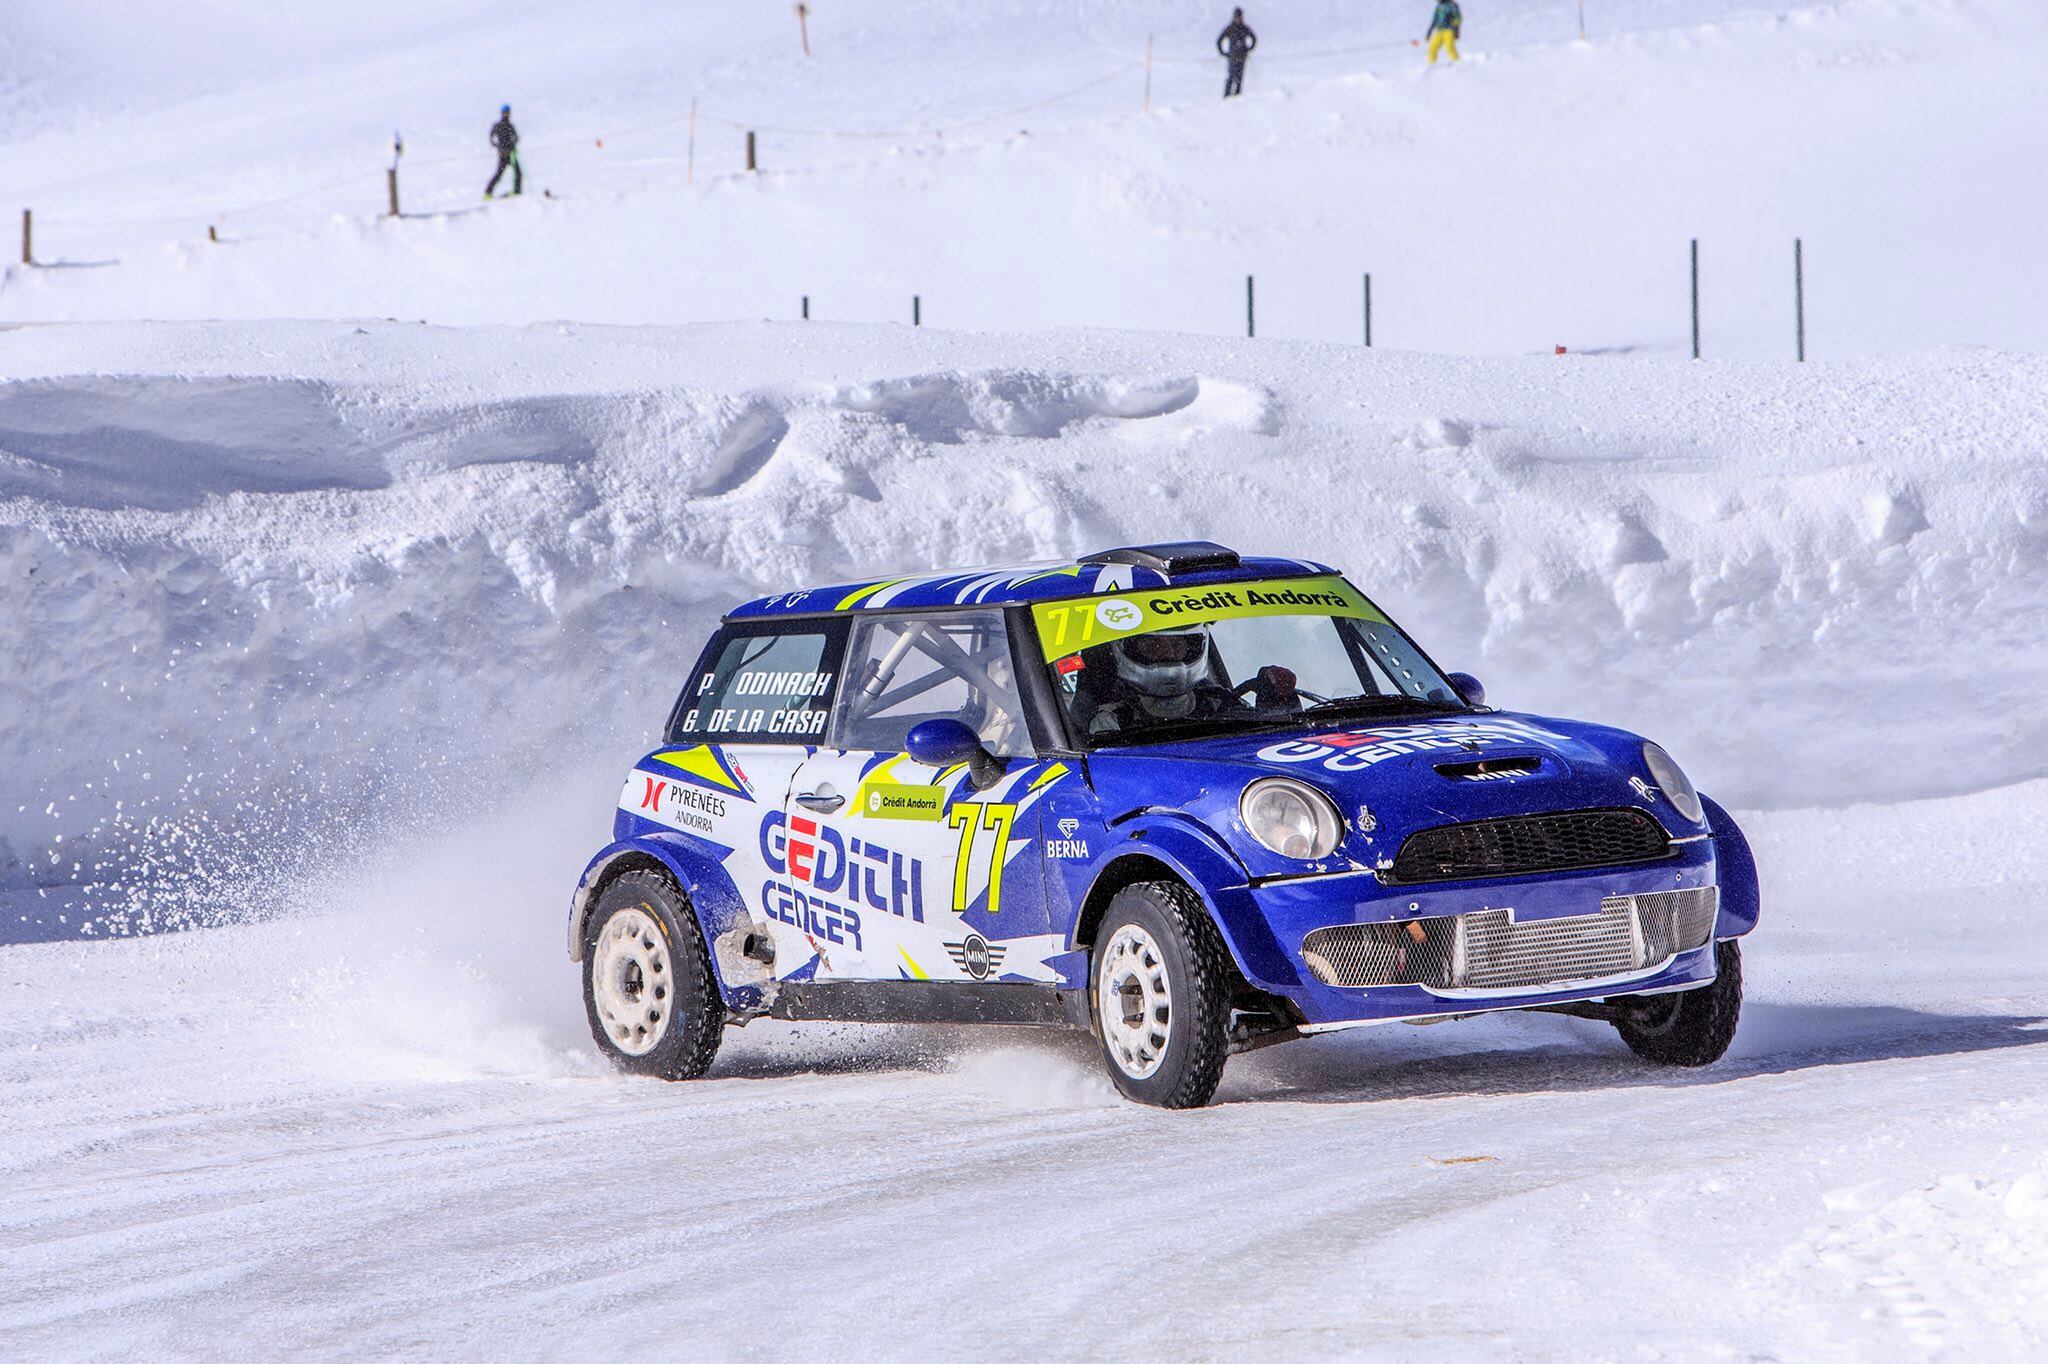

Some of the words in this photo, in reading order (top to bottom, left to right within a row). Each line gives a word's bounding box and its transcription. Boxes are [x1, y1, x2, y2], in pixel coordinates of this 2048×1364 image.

[1149, 591, 1242, 616] Crèdit
[1248, 588, 1350, 608] Andorrà
[1048, 604, 1097, 646] 77
[696, 673, 715, 696] P.
[735, 672, 832, 696] ODINACH
[706, 709, 736, 733] DE
[736, 709, 764, 733] LA
[767, 709, 828, 734] CASA
[1463, 768, 1532, 781] MINI
[670, 785, 726, 817] PYRÉNÉES
[882, 796, 905, 808] Crèdit
[907, 797, 937, 809] Andorrà
[674, 810, 713, 834] ANDORRA
[949, 802, 1019, 913] 77
[1047, 840, 1089, 858] BERNA
[967, 950, 987, 964] MINI
